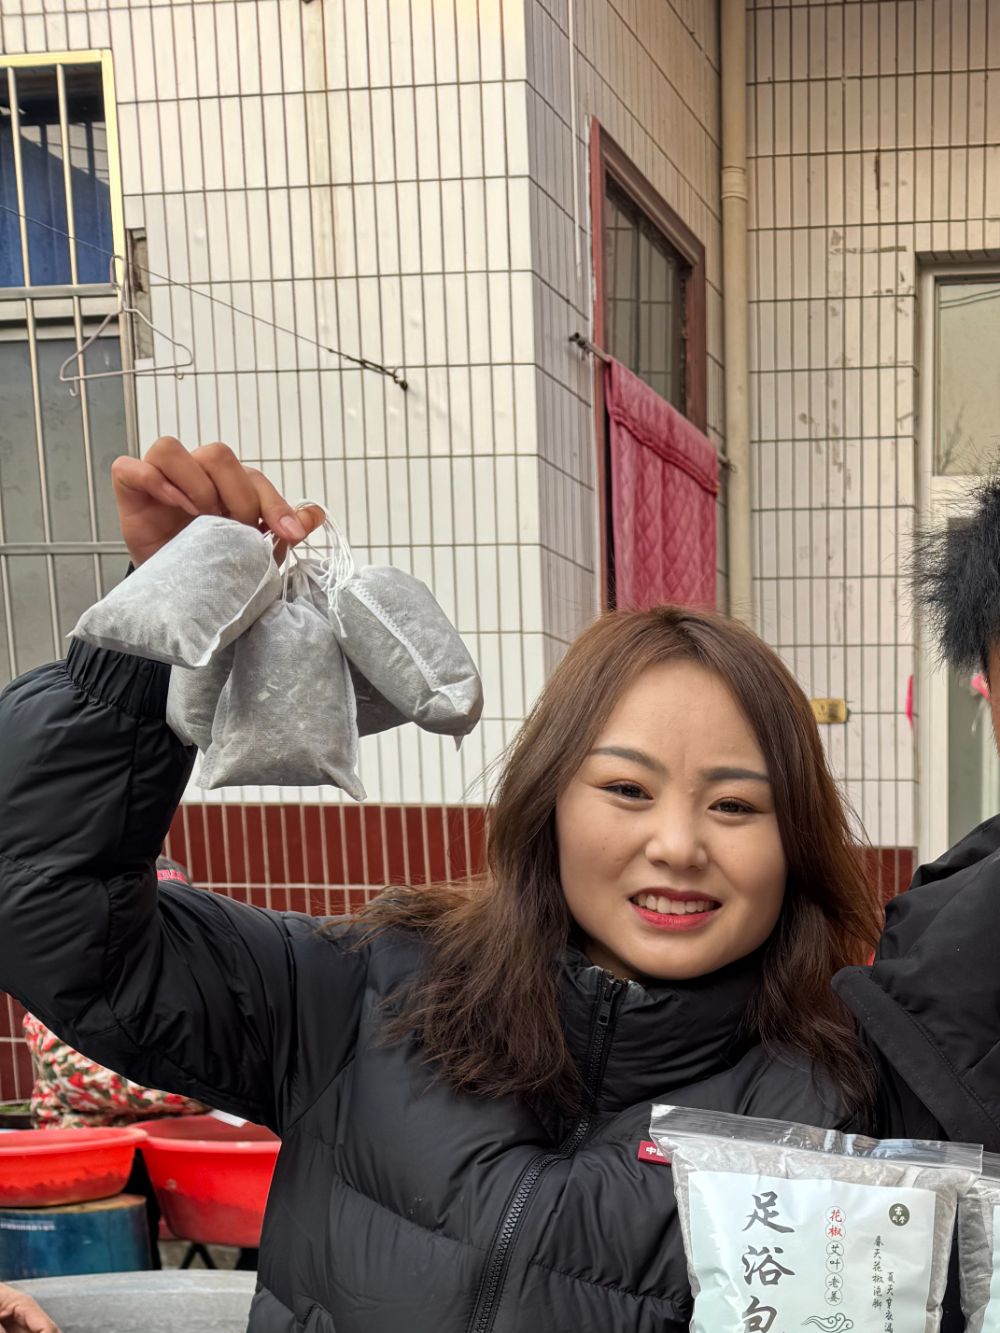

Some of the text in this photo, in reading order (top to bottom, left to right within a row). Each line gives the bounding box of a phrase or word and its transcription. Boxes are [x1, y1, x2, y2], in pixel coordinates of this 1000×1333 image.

[826, 1208, 844, 1304] 花椒艾叶老姜
[871, 1235, 885, 1310] 春天花椒泡脚
